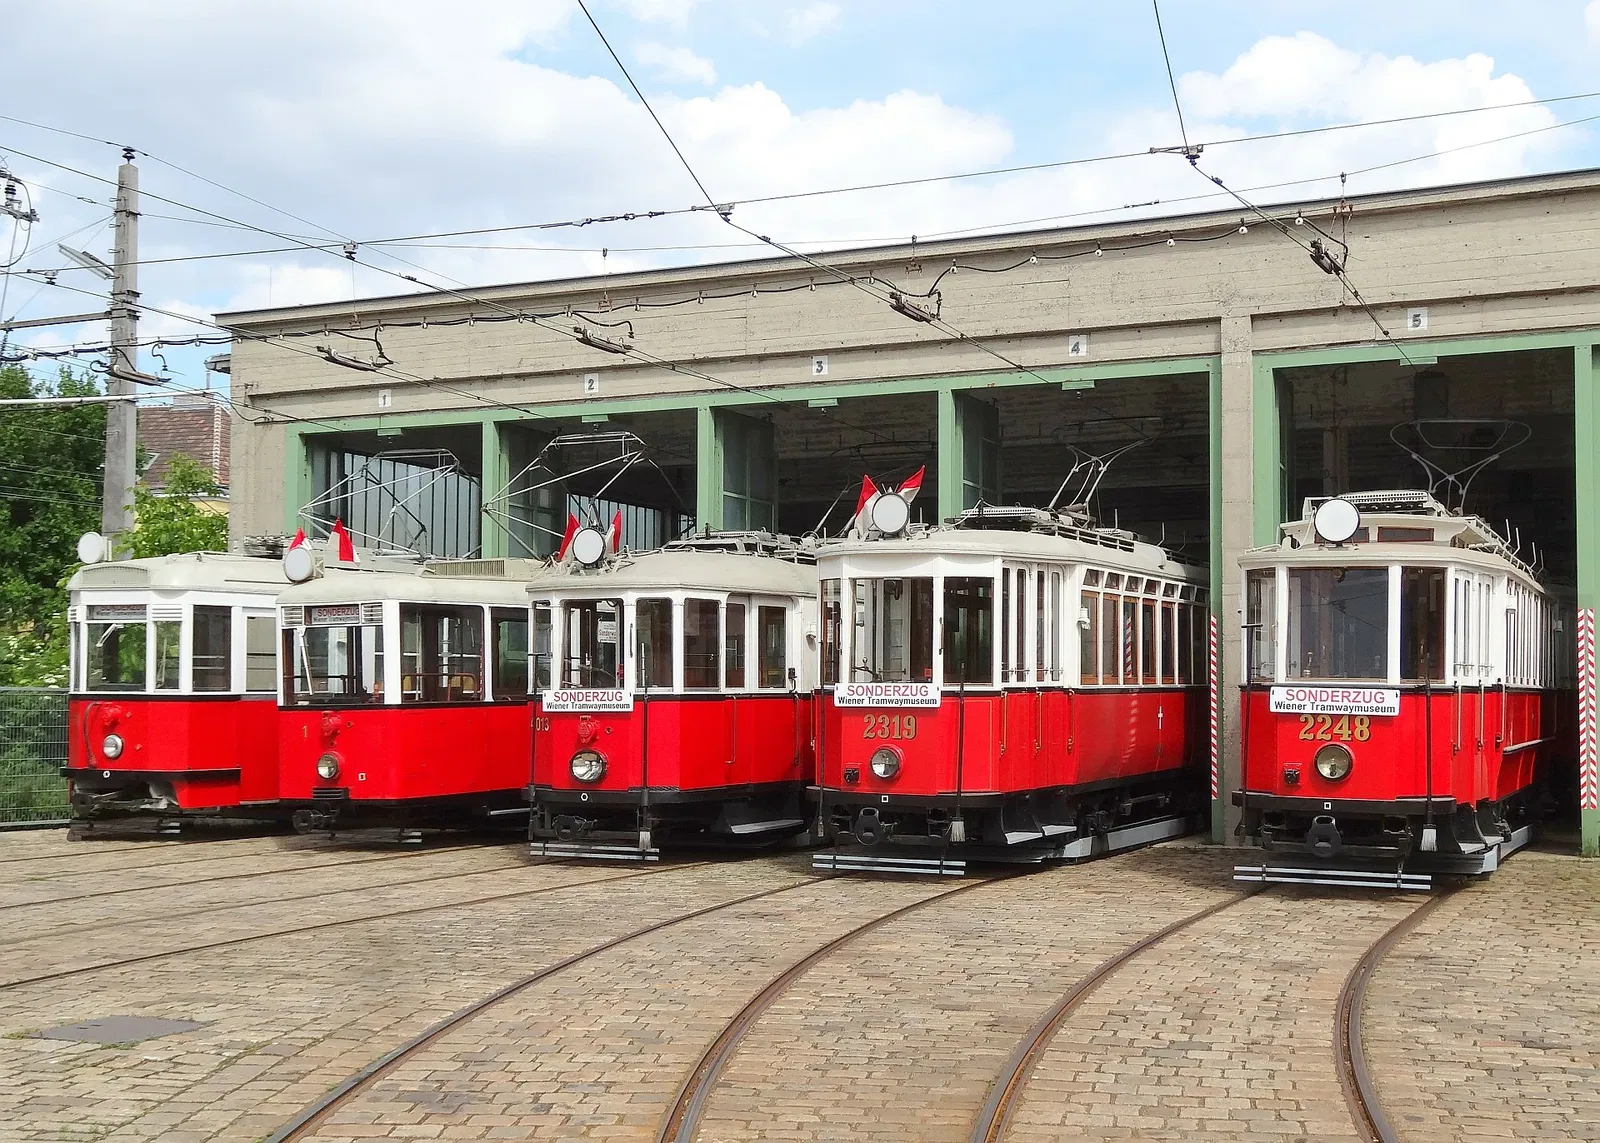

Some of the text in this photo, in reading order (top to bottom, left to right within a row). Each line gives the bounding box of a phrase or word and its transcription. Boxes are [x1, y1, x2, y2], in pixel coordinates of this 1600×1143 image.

[1411, 313, 1422, 328] 5
[1071, 341, 1081, 354] 4
[816, 360, 824, 374] 3
[587, 378, 595, 390] 2
[553, 691, 623, 702] SONDERZUG
[847, 685, 929, 697] SONDERZUG
[1285, 689, 1385, 704] SONDERZUG
[546, 701, 631, 711] Wiener Tramwaymuseum
[838, 696, 938, 707] Wiener Tramwaymuseum
[1274, 700, 1396, 714] Wiener Tramwaymuseum
[863, 714, 917, 740] 2319
[1299, 714, 1371, 742] 2248
